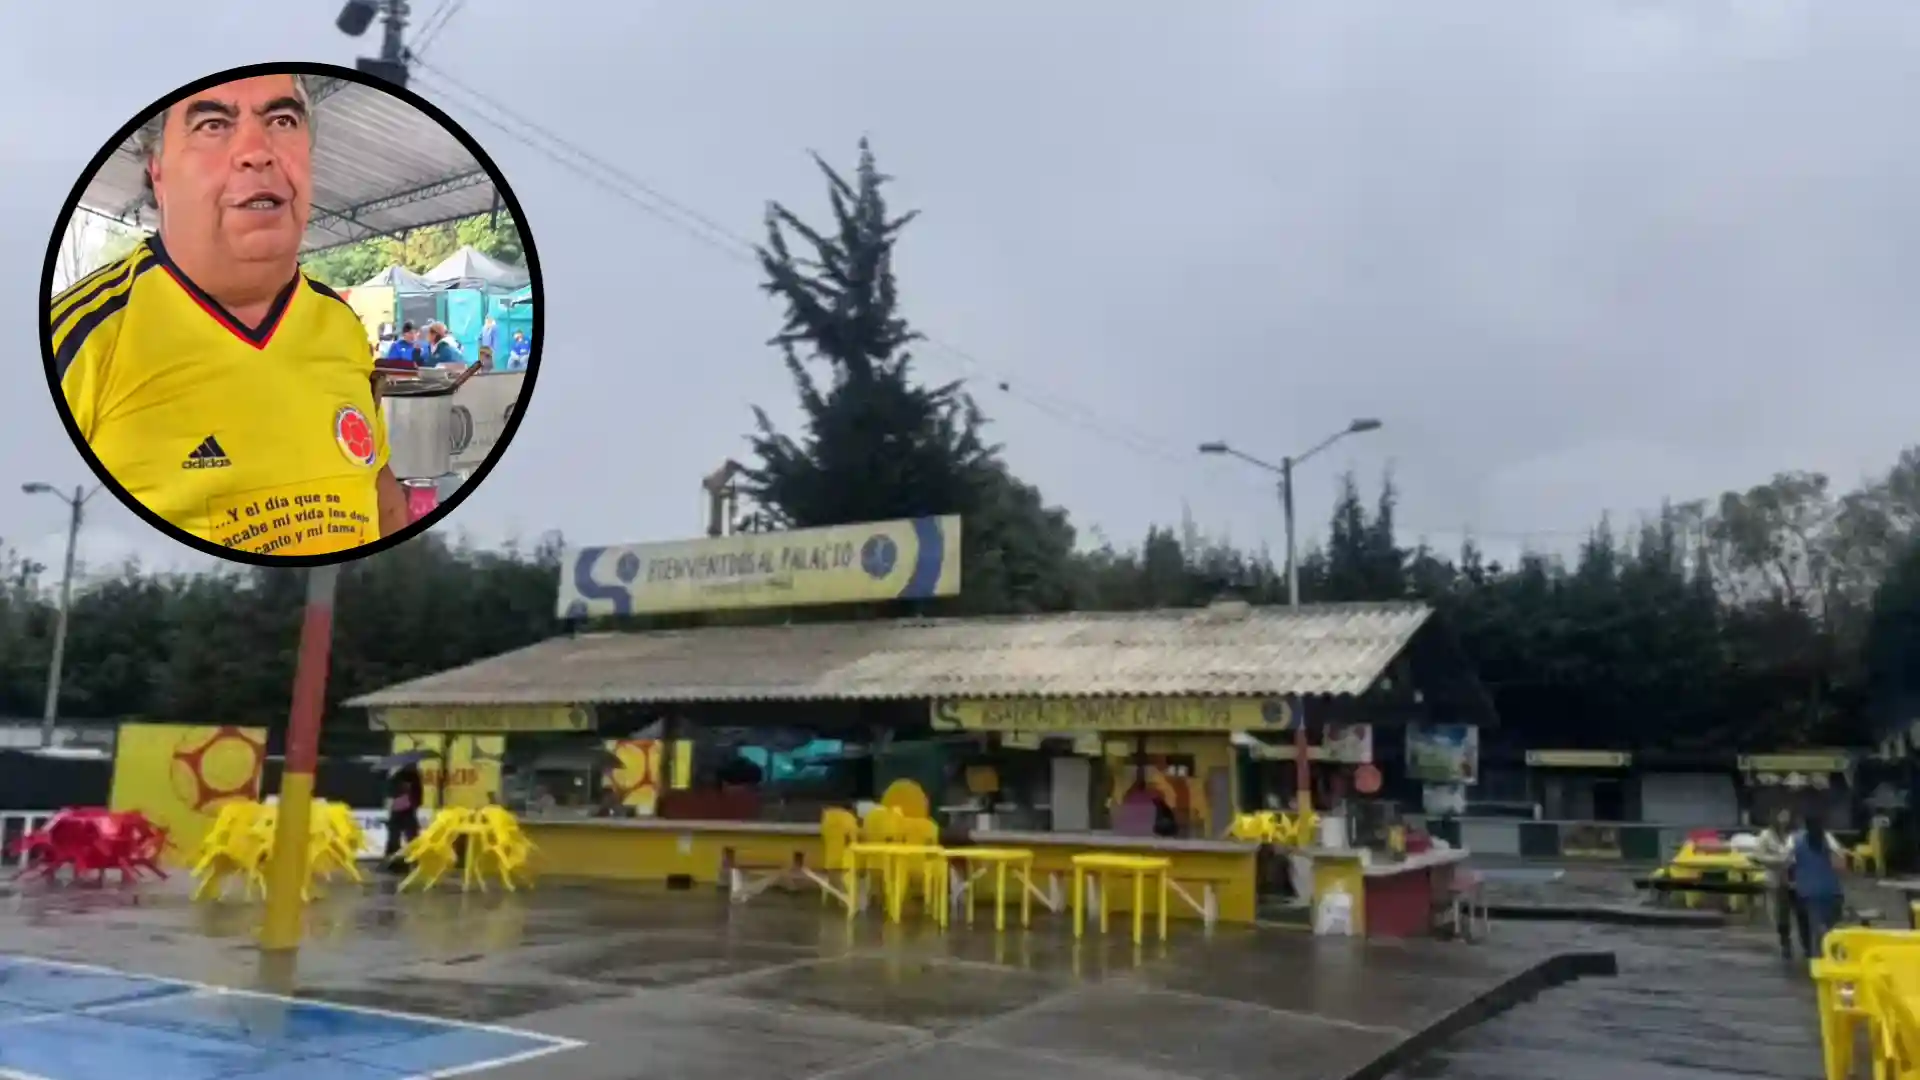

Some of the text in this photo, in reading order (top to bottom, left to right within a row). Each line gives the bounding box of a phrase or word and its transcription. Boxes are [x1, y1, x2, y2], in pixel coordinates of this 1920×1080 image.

[182, 457, 232, 469] adidas
[245, 501, 260, 517] el
[294, 494, 321, 507] que
[326, 494, 341, 504] se
[222, 523, 269, 548] acabe
[273, 513, 290, 529] mi
[295, 508, 324, 522] vida
[328, 507, 347, 519] les
[254, 523, 356, 554] canto y mi fama
